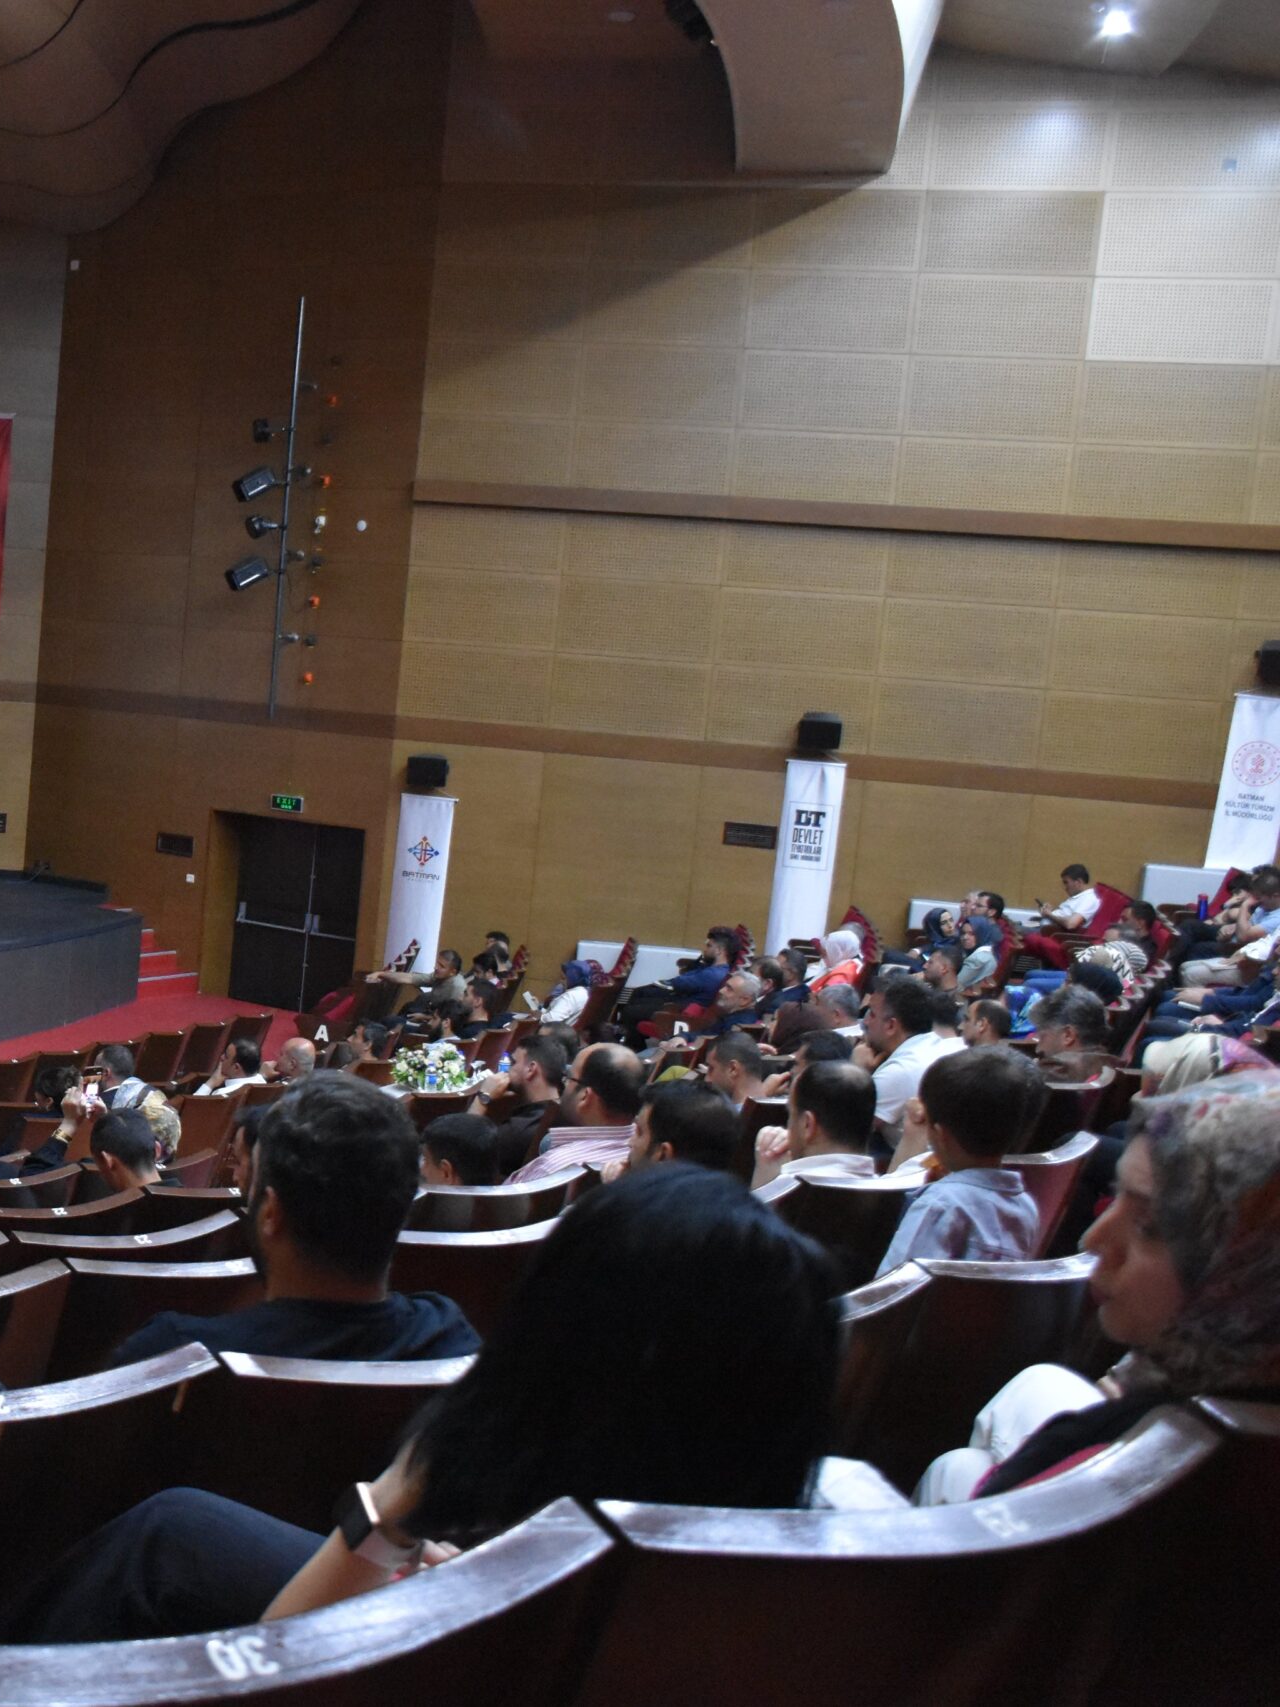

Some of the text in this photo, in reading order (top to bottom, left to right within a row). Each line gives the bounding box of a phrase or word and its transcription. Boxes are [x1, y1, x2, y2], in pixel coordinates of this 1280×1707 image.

[792, 827, 824, 846] DEVLET
[315, 1024, 329, 1042] A
[206, 1633, 281, 1681] 30
